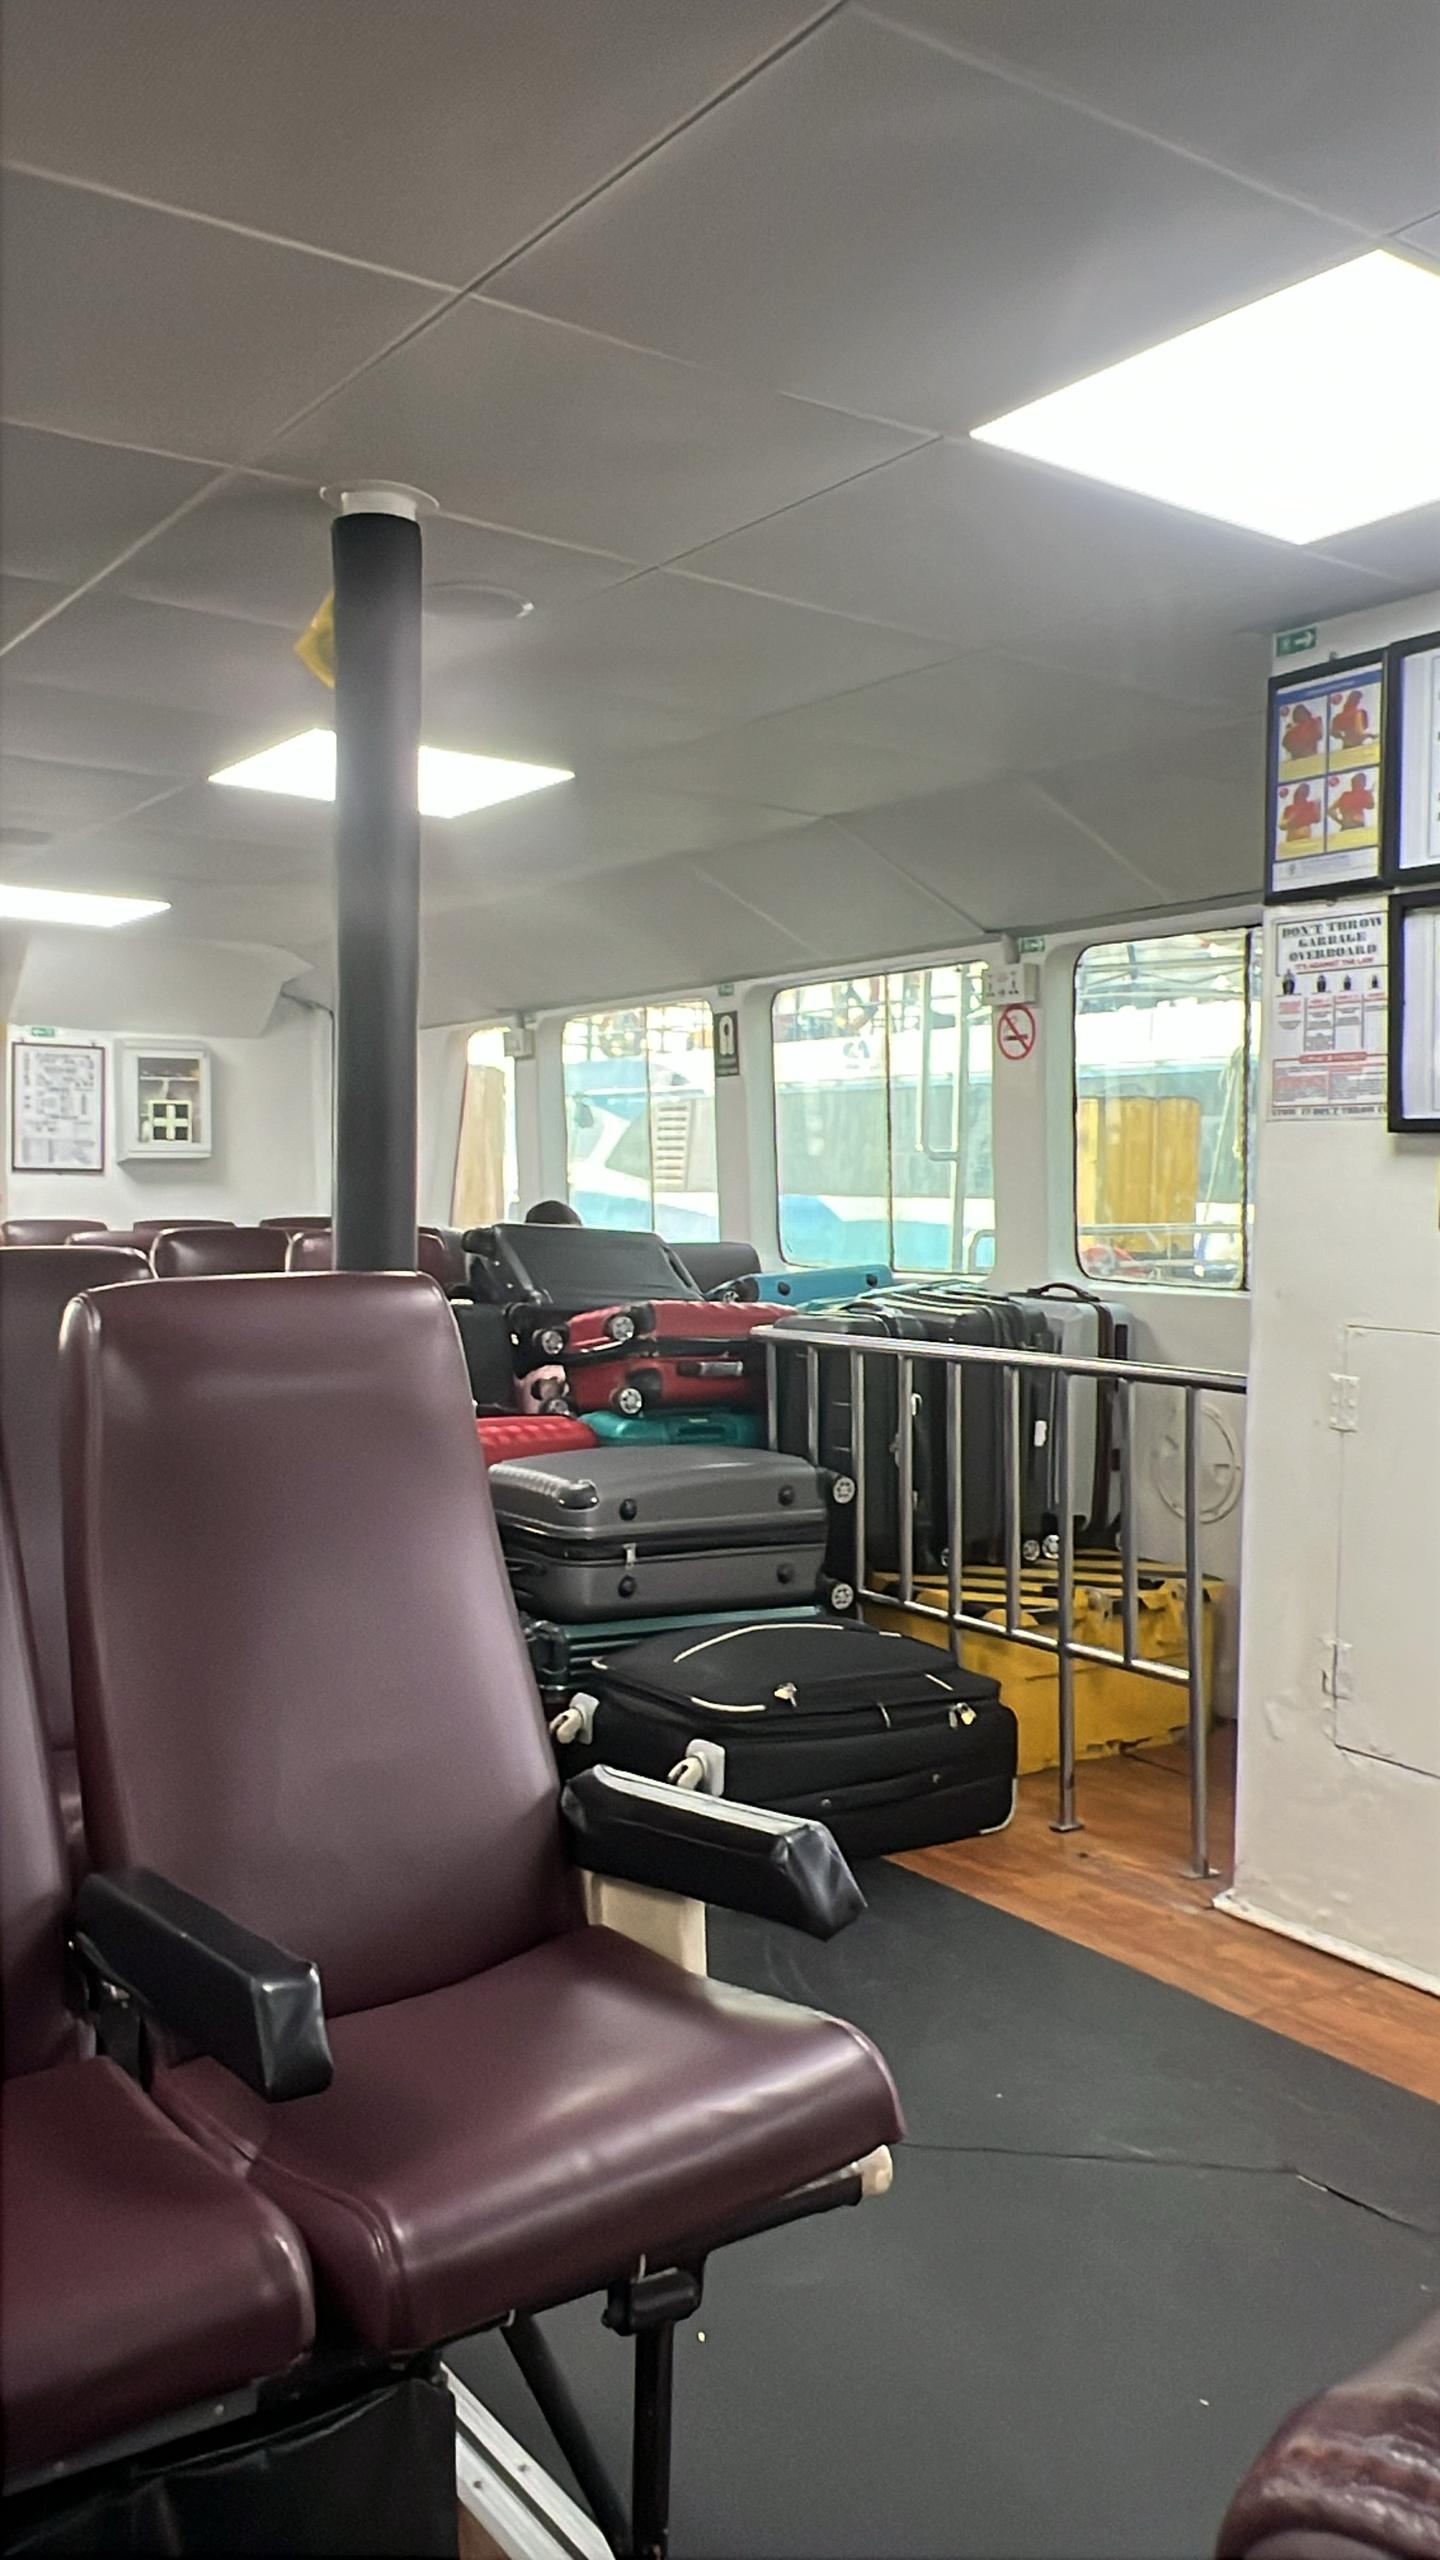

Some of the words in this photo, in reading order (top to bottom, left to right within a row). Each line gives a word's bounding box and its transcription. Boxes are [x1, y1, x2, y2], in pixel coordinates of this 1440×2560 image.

[1282, 924, 1323, 938] DON'T
[1326, 917, 1382, 931] THROW
[1298, 932, 1367, 947] GARBAGE
[1289, 944, 1377, 961] OVERBOARD
